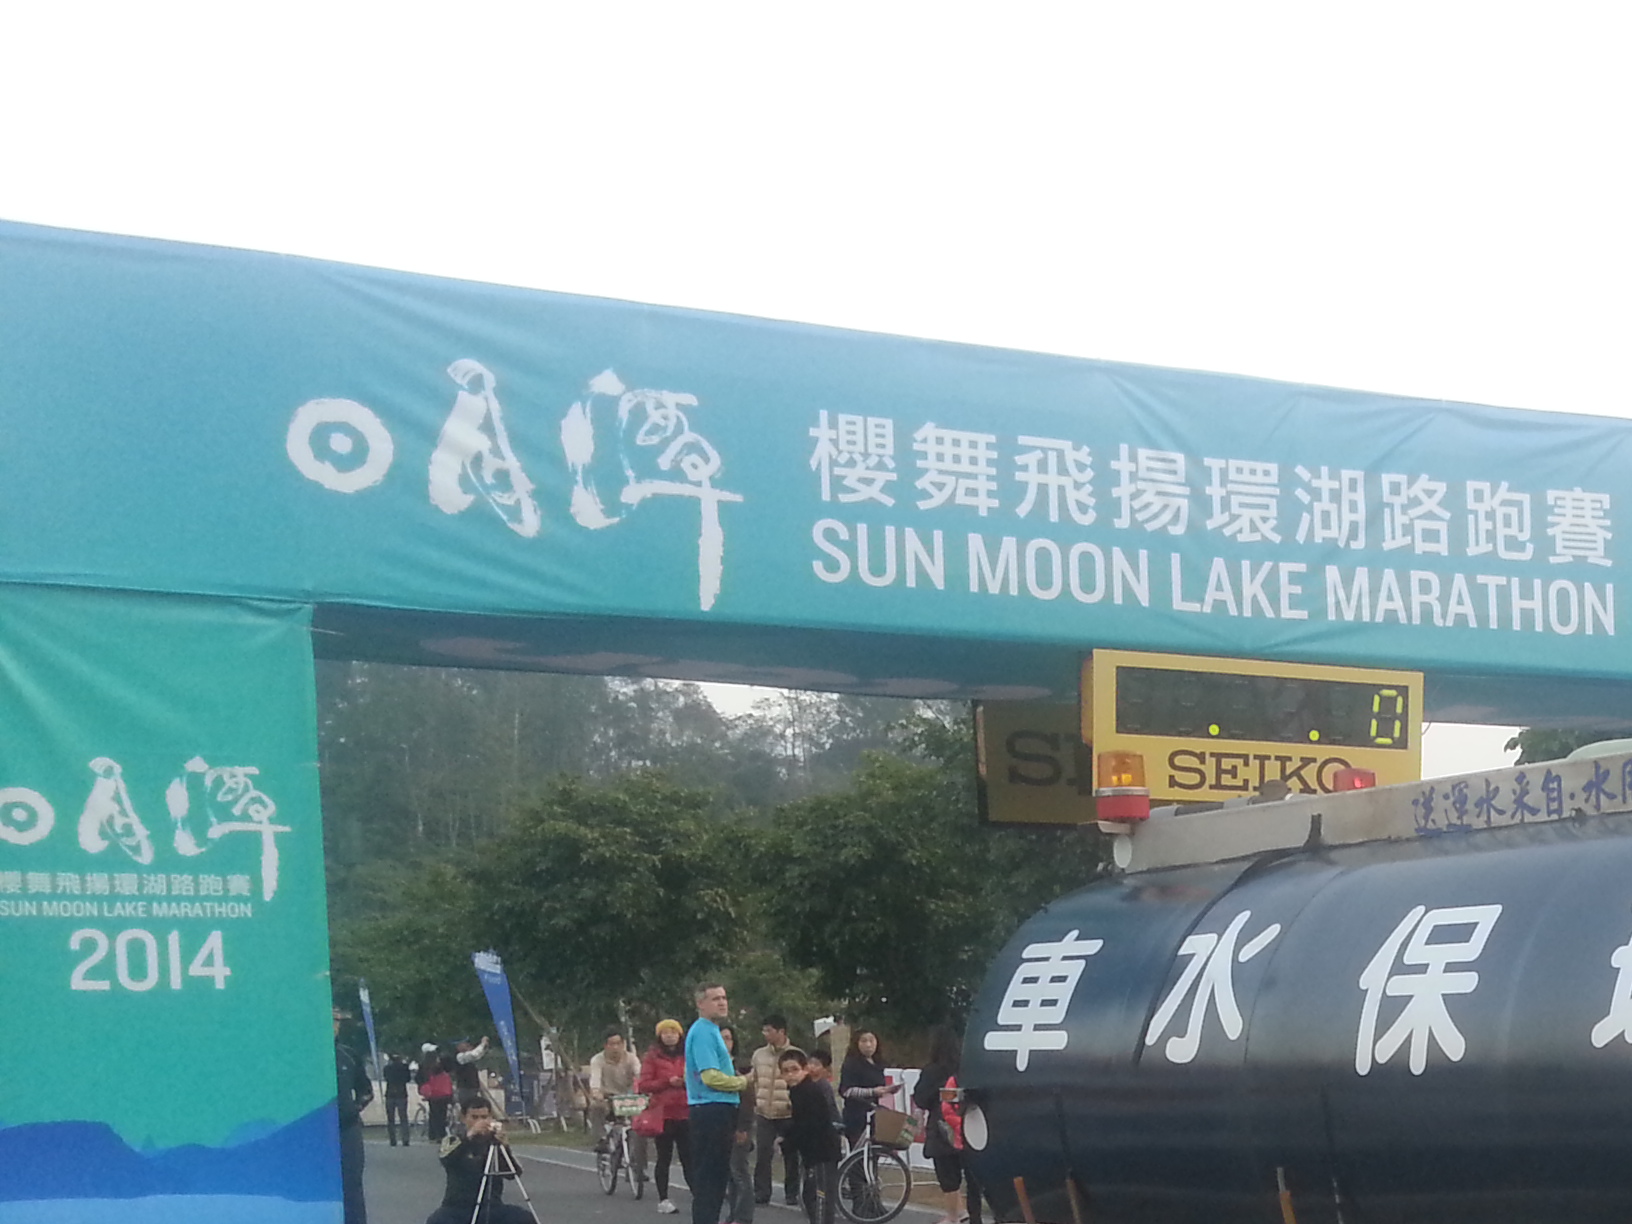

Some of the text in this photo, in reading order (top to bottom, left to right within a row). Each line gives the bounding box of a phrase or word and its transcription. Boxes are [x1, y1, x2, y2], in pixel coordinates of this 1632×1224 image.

[809, 409, 1613, 567] 櫻舞飛揚環湖路跑賽
[812, 518, 1616, 636] SUN MOON LAKE MARATHON
[0, 901, 252, 918] SUN MOON LAKE MARATHON
[69, 928, 232, 992] 2014
